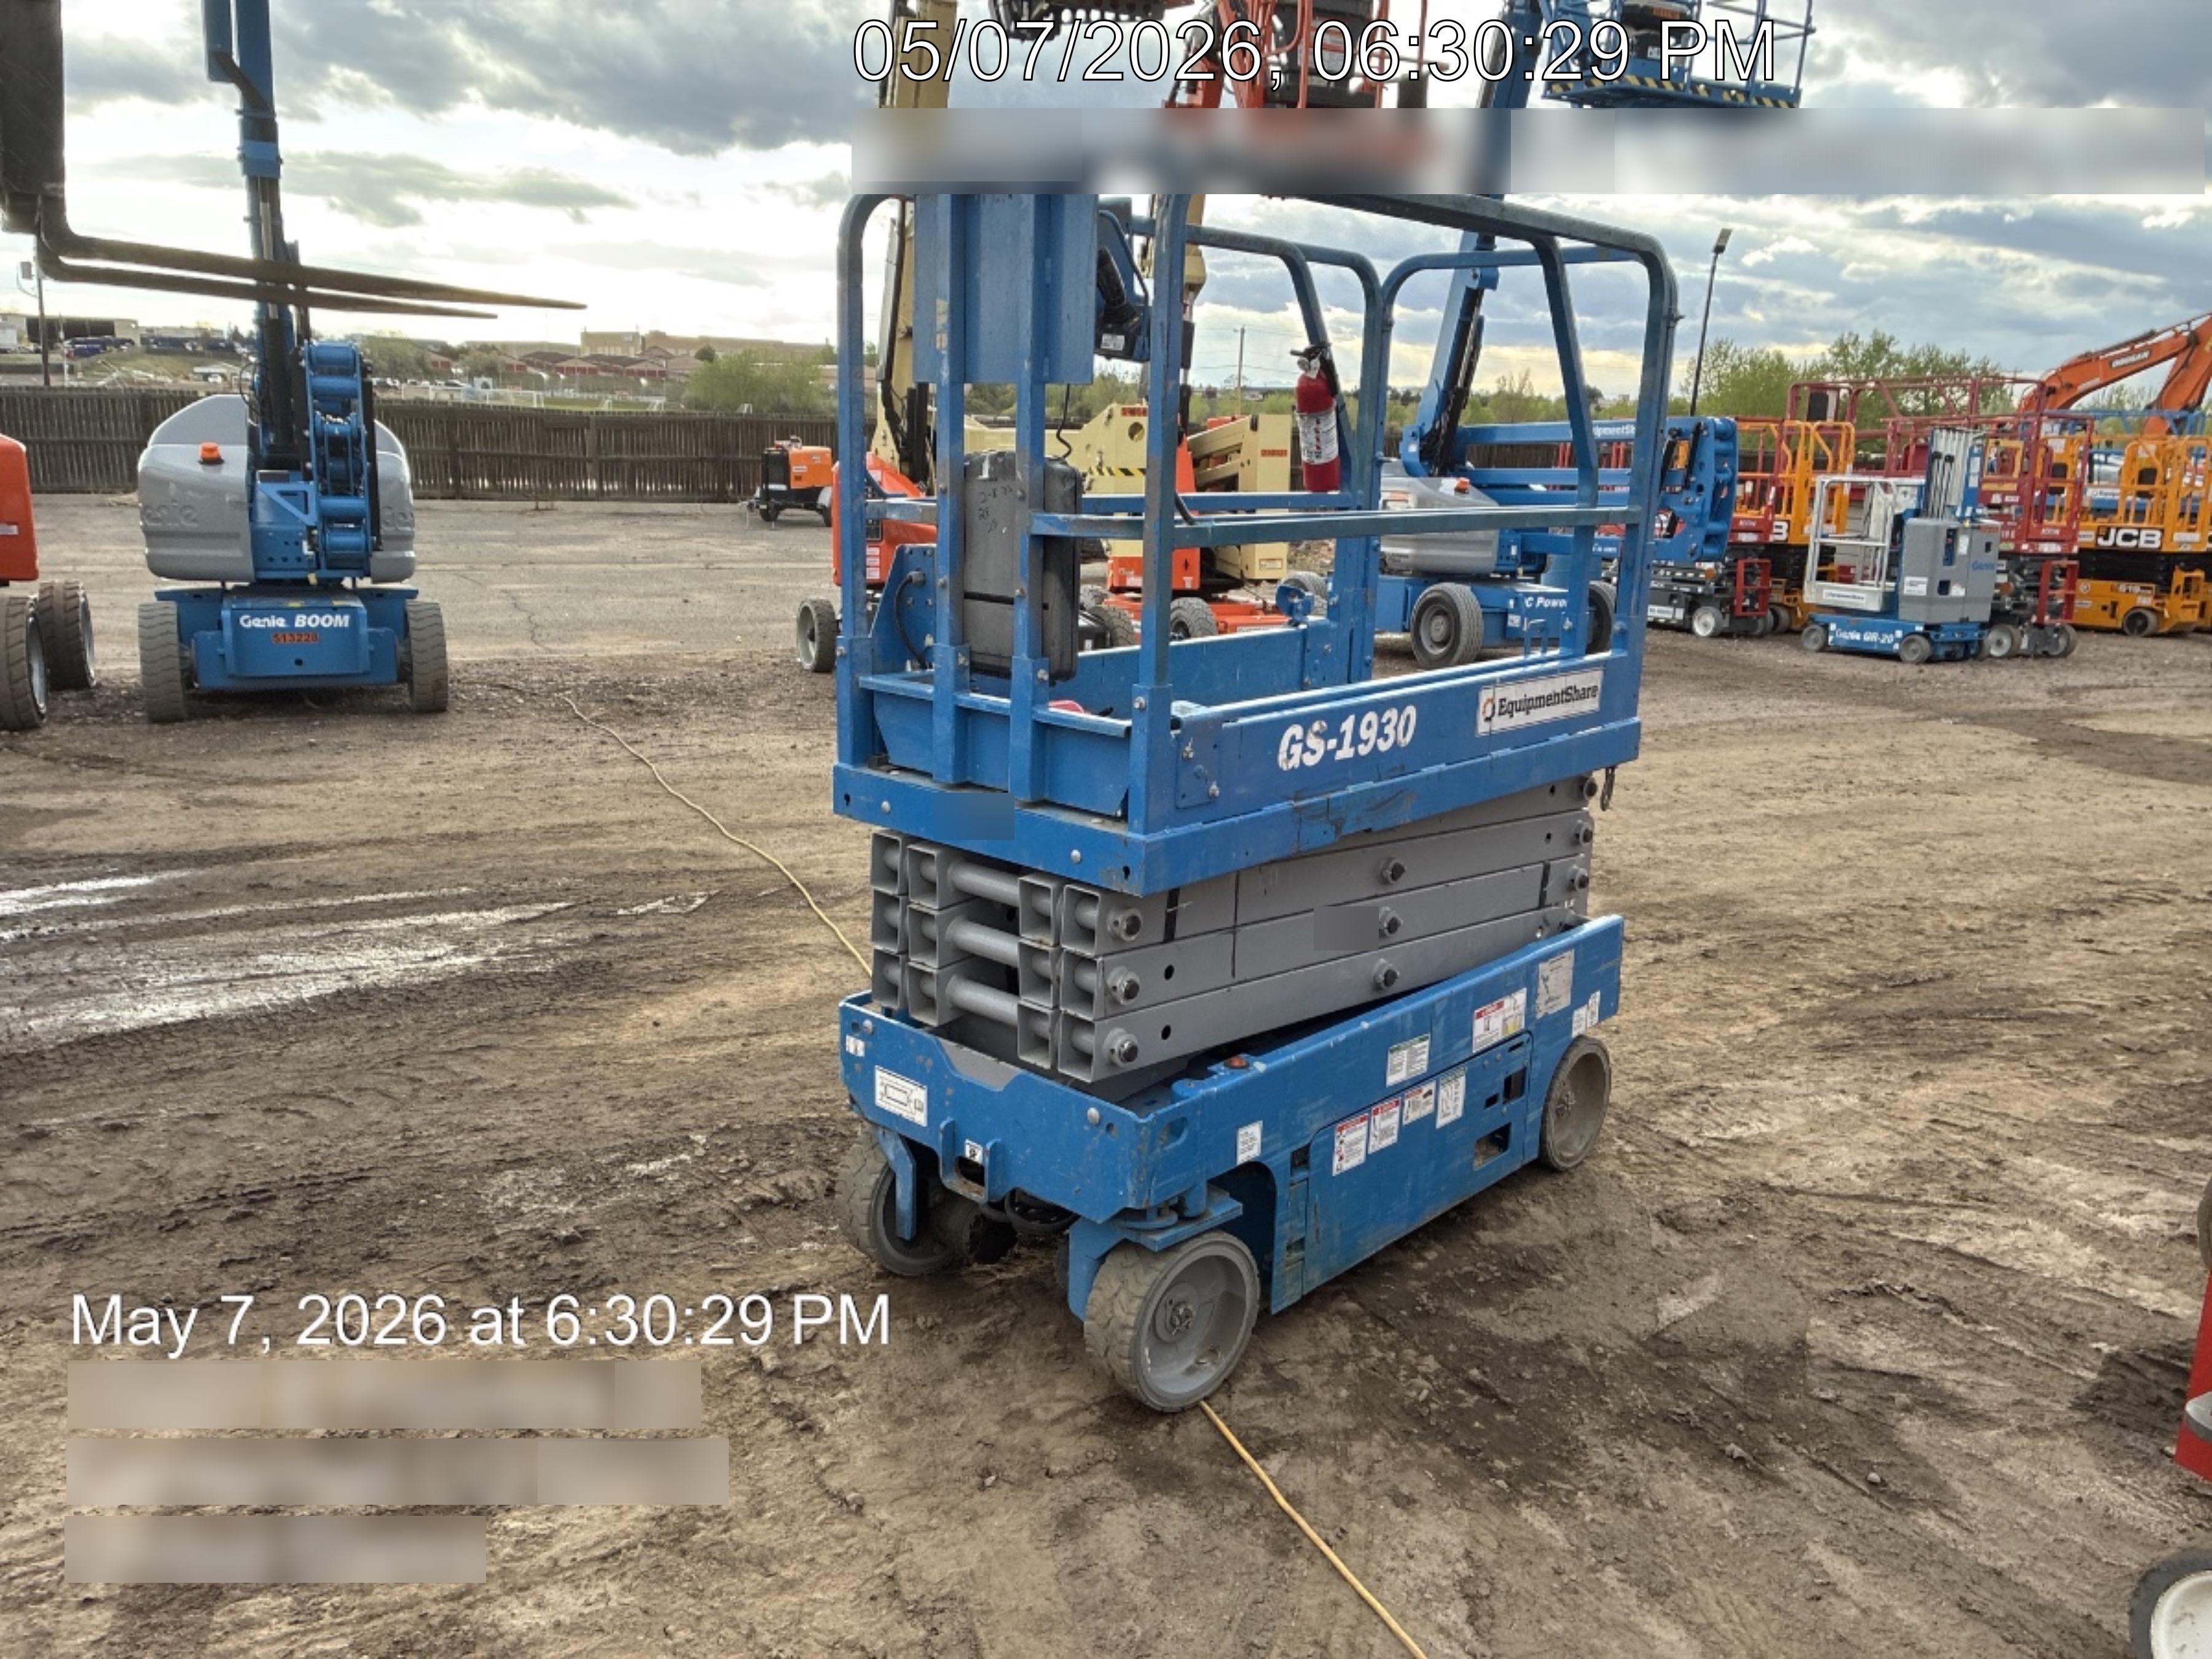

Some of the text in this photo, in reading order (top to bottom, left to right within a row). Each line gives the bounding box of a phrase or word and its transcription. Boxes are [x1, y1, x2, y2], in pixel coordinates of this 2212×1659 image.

[2097, 527, 2162, 549] JCB
[239, 614, 350, 628] Genie BOOM
[1497, 684, 1599, 718] EquipmentShare
[1277, 704, 1417, 771] GS-1930
